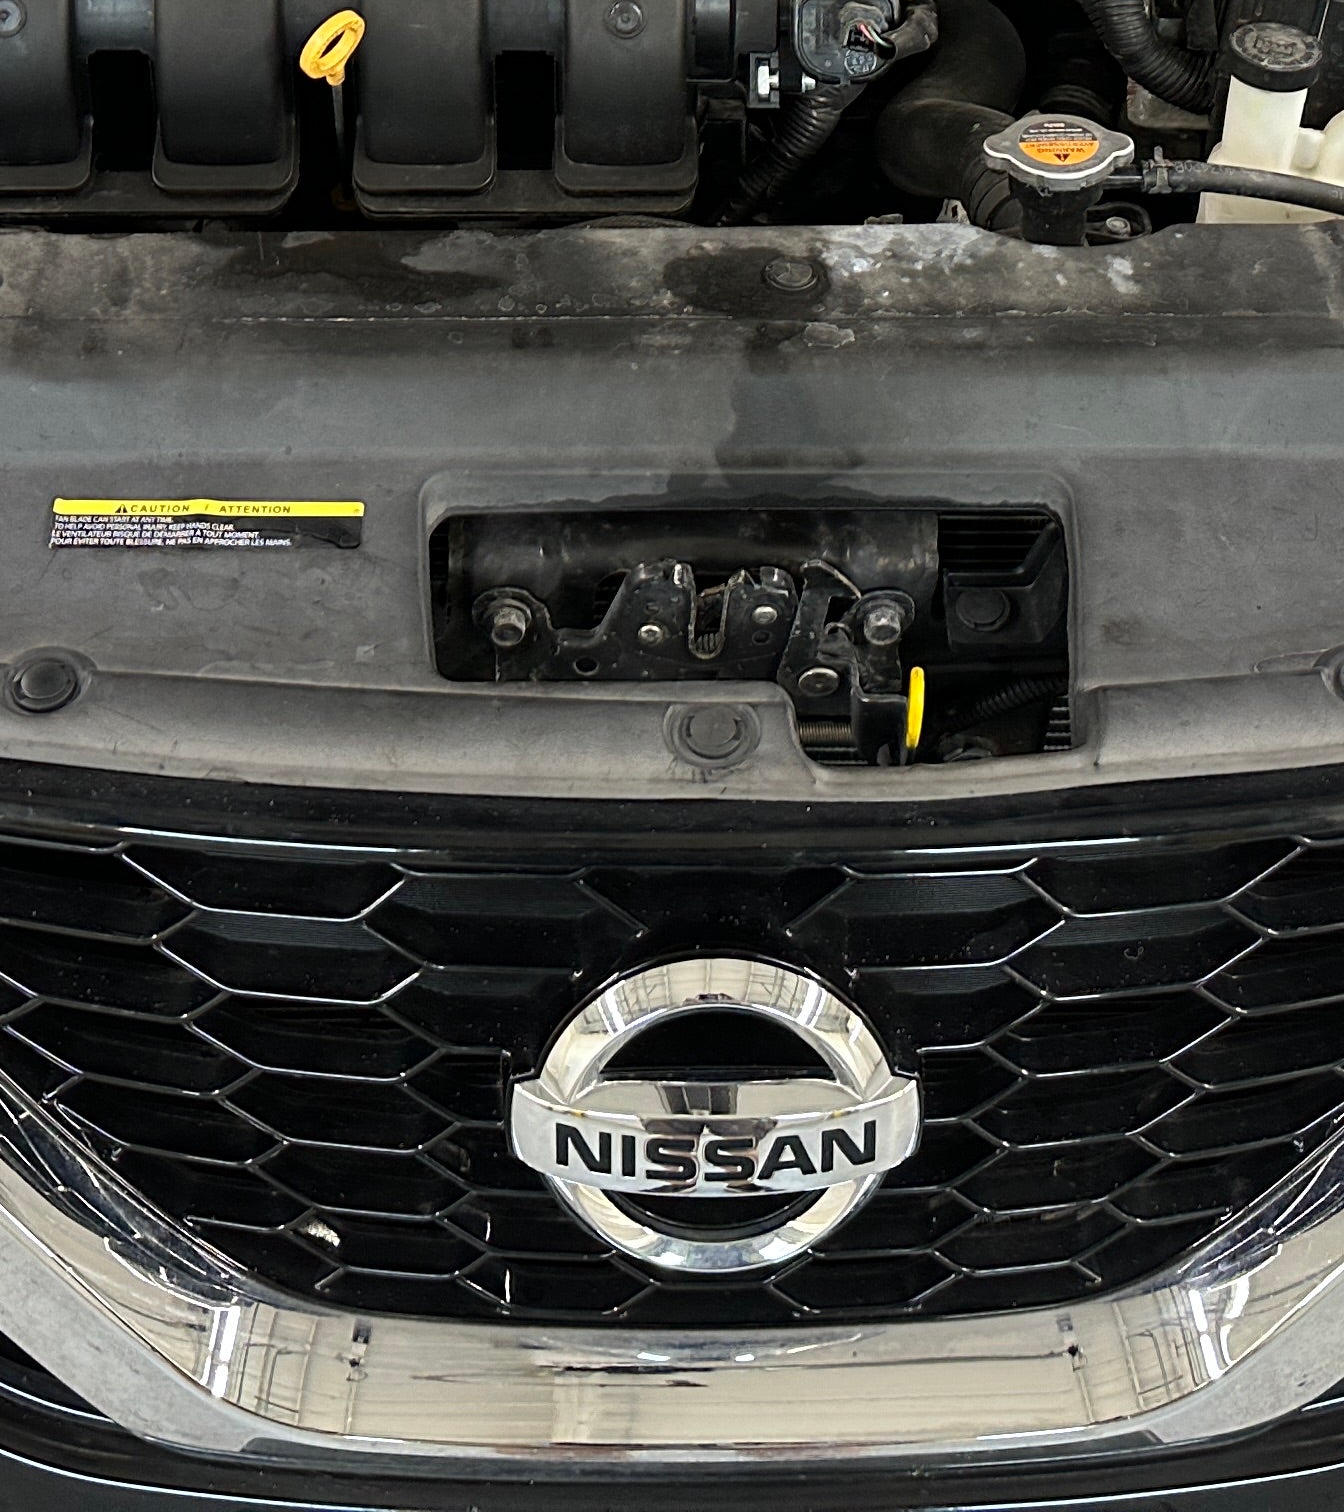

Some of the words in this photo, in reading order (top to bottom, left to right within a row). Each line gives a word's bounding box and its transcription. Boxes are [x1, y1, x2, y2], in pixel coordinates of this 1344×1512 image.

[130, 504, 191, 513] CAUTION
[219, 505, 291, 514] ATTENTION
[202, 529, 223, 538] TOUT
[177, 537, 192, 545] PAS
[204, 538, 250, 546] APPROCHER
[555, 1119, 878, 1184] NISSAN
